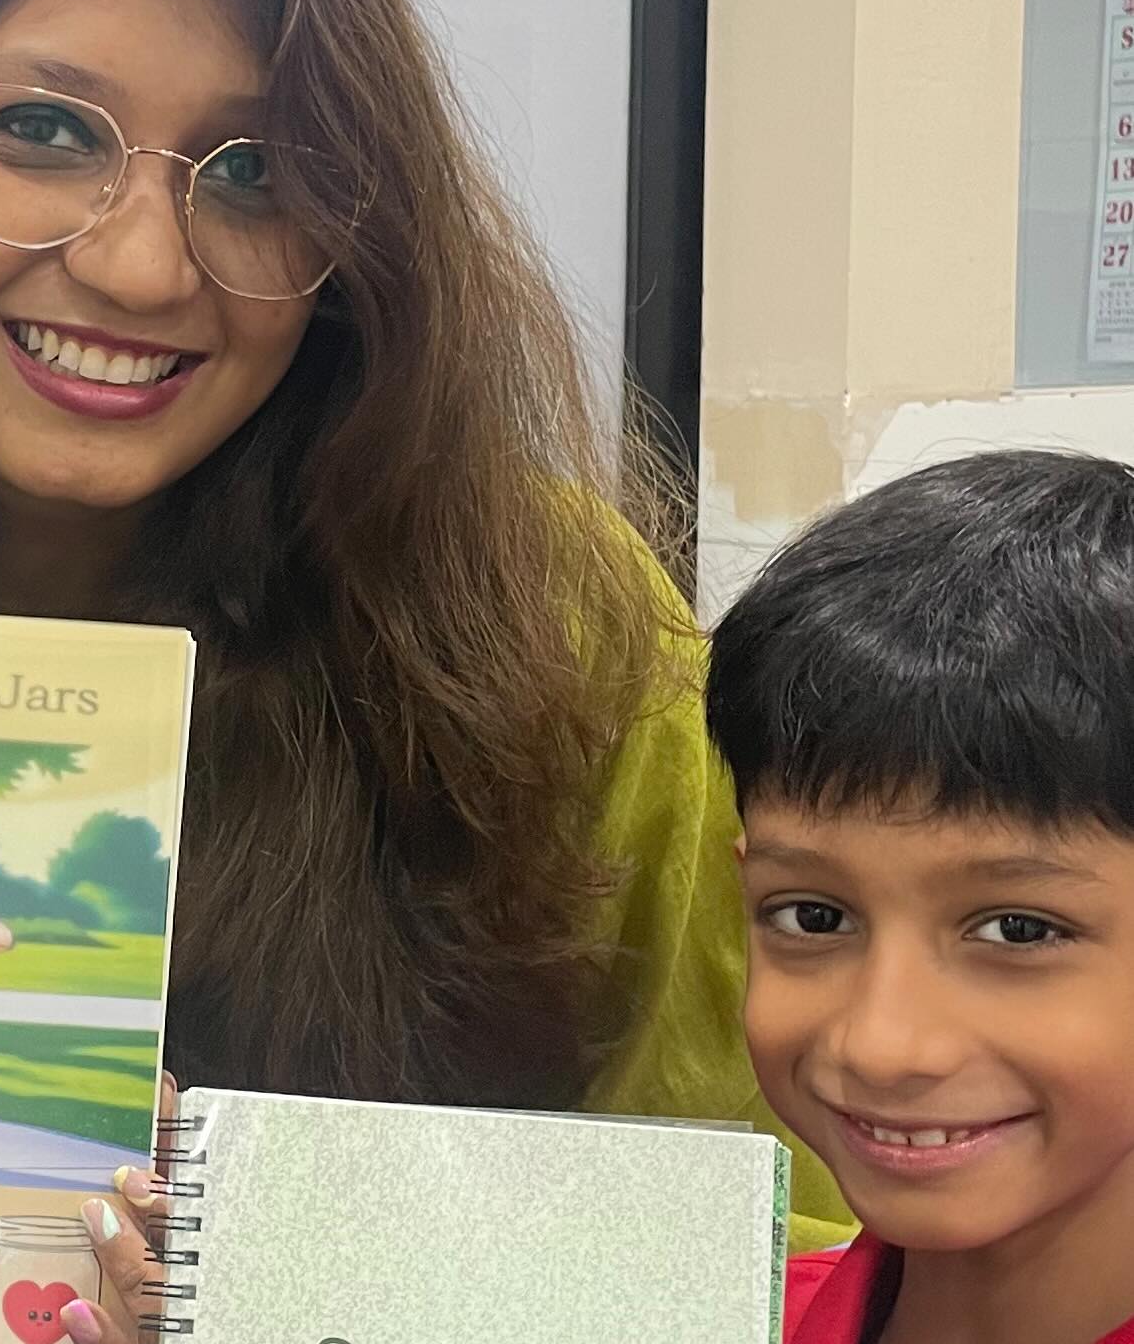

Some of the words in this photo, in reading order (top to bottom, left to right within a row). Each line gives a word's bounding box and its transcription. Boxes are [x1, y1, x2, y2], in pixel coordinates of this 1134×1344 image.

[1118, 114, 1132, 137] 6
[1111, 158, 1134, 182] 13
[1106, 201, 1133, 225] 20
[1103, 244, 1129, 267] 27
